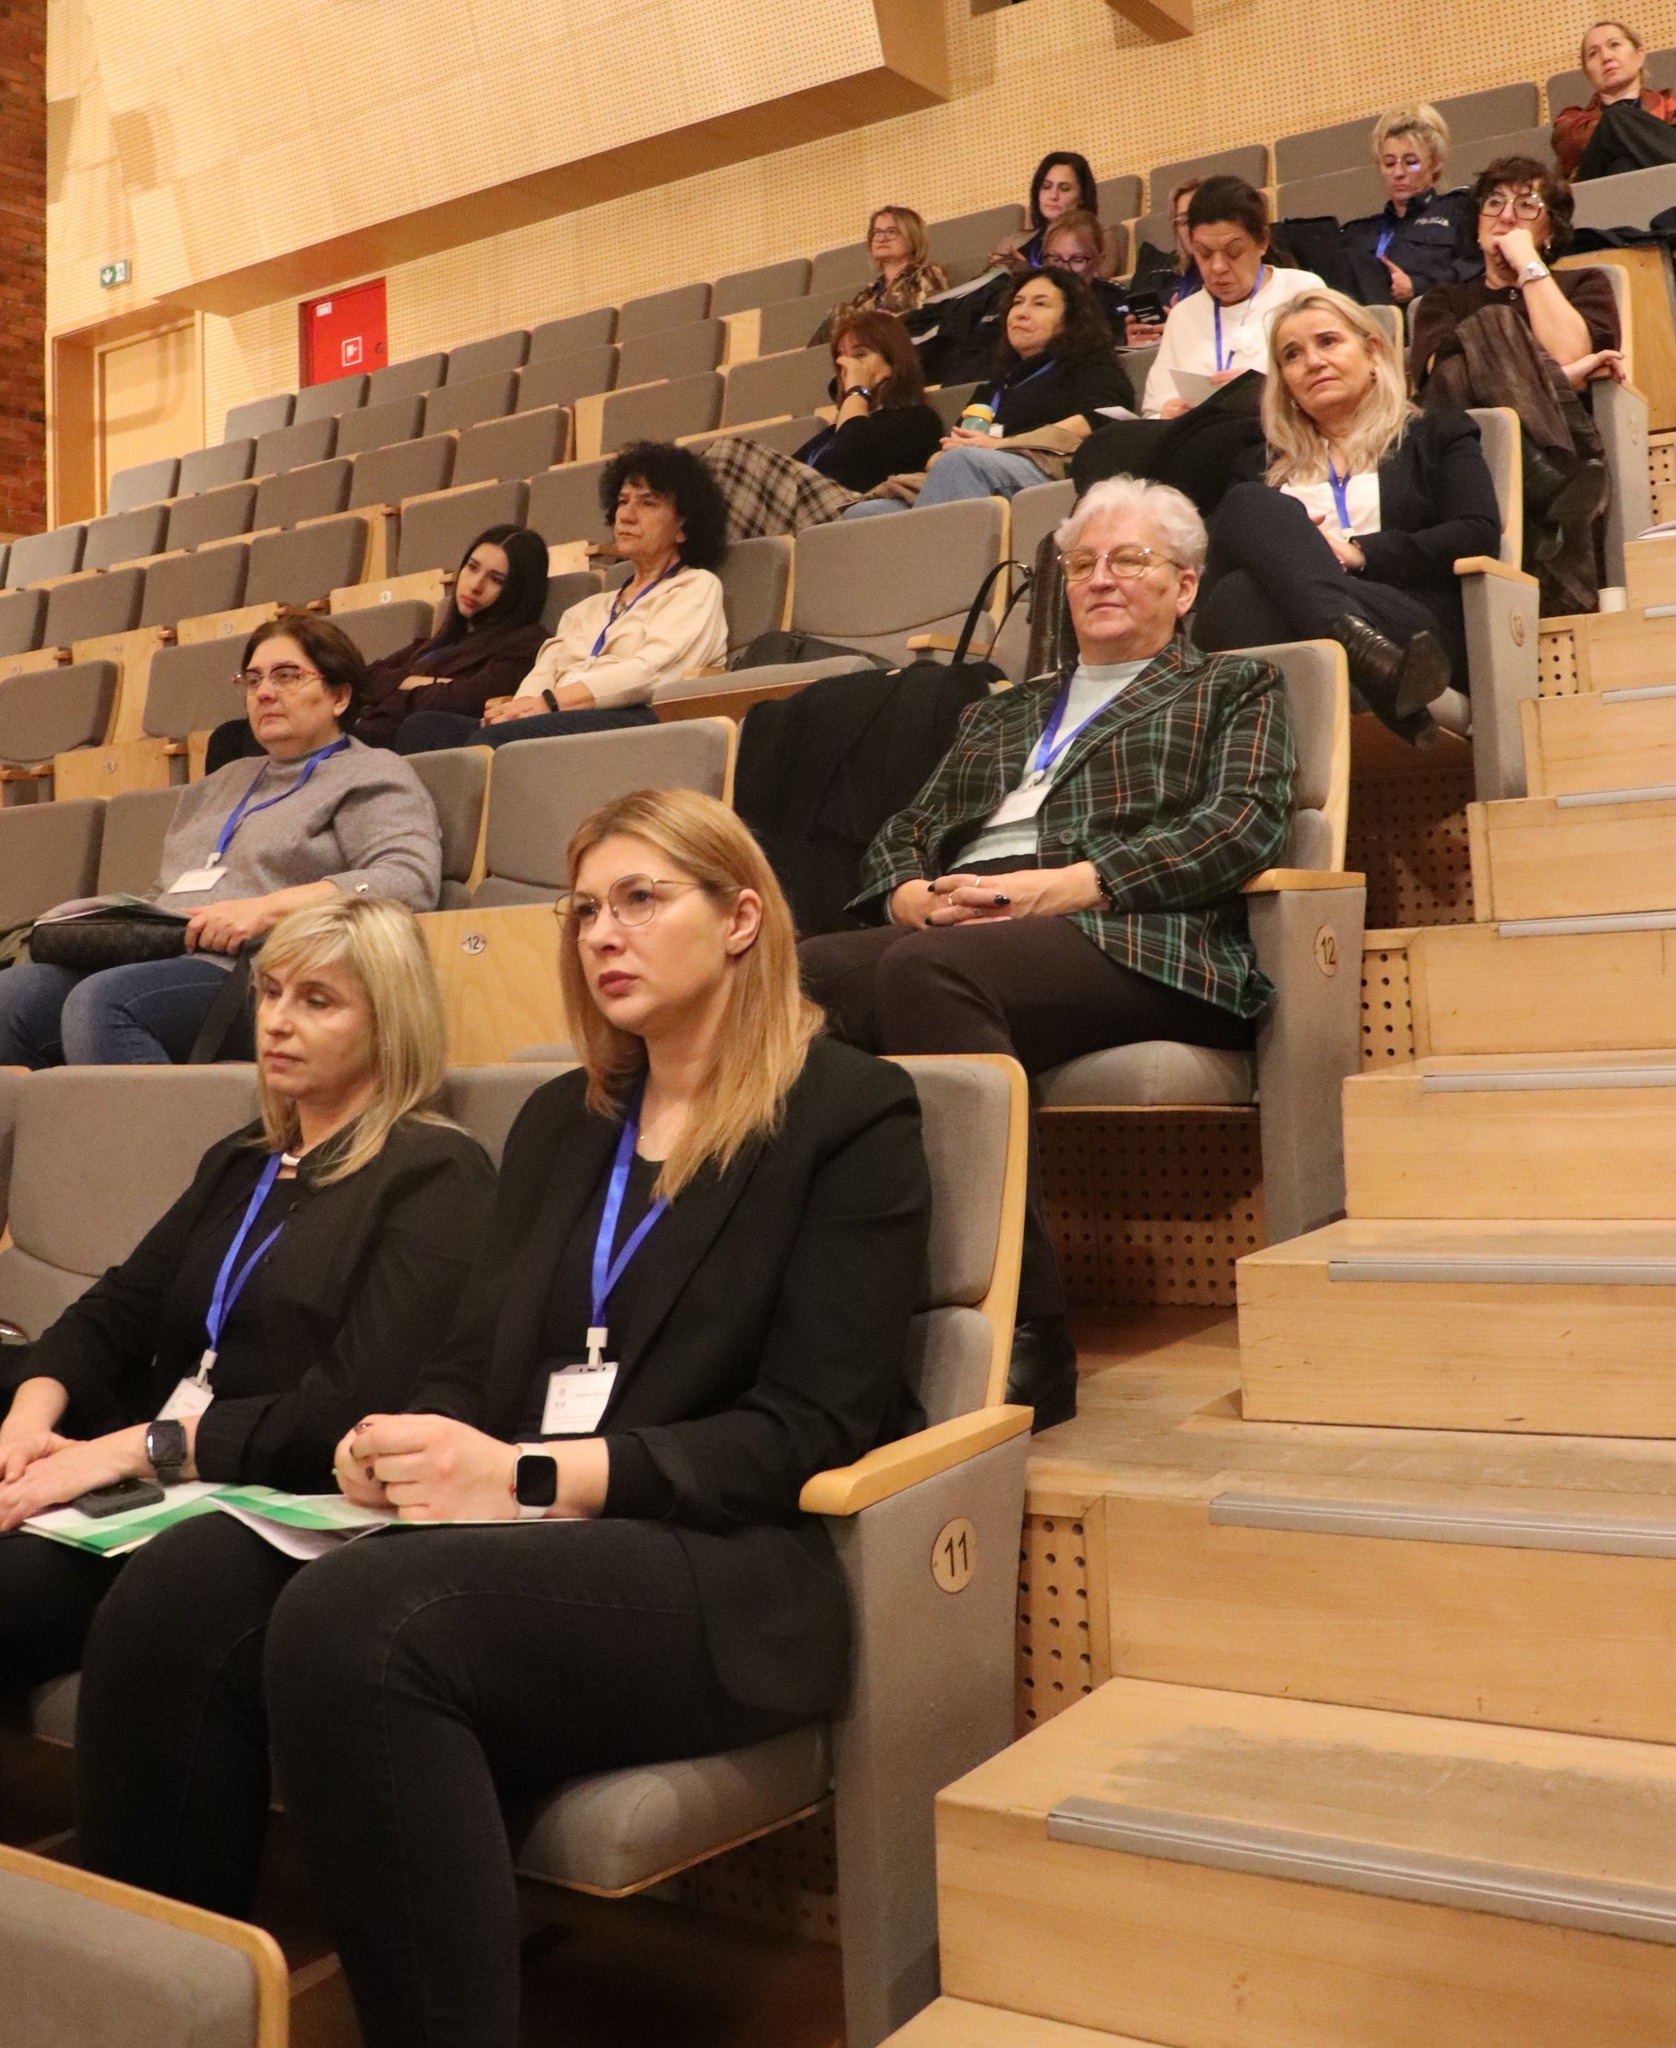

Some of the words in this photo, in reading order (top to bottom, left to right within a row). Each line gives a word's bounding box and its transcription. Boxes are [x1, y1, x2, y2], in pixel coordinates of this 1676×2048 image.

[466, 935, 480, 950] 12
[1321, 936, 1336, 965] 12
[944, 1531, 968, 1577] 11
